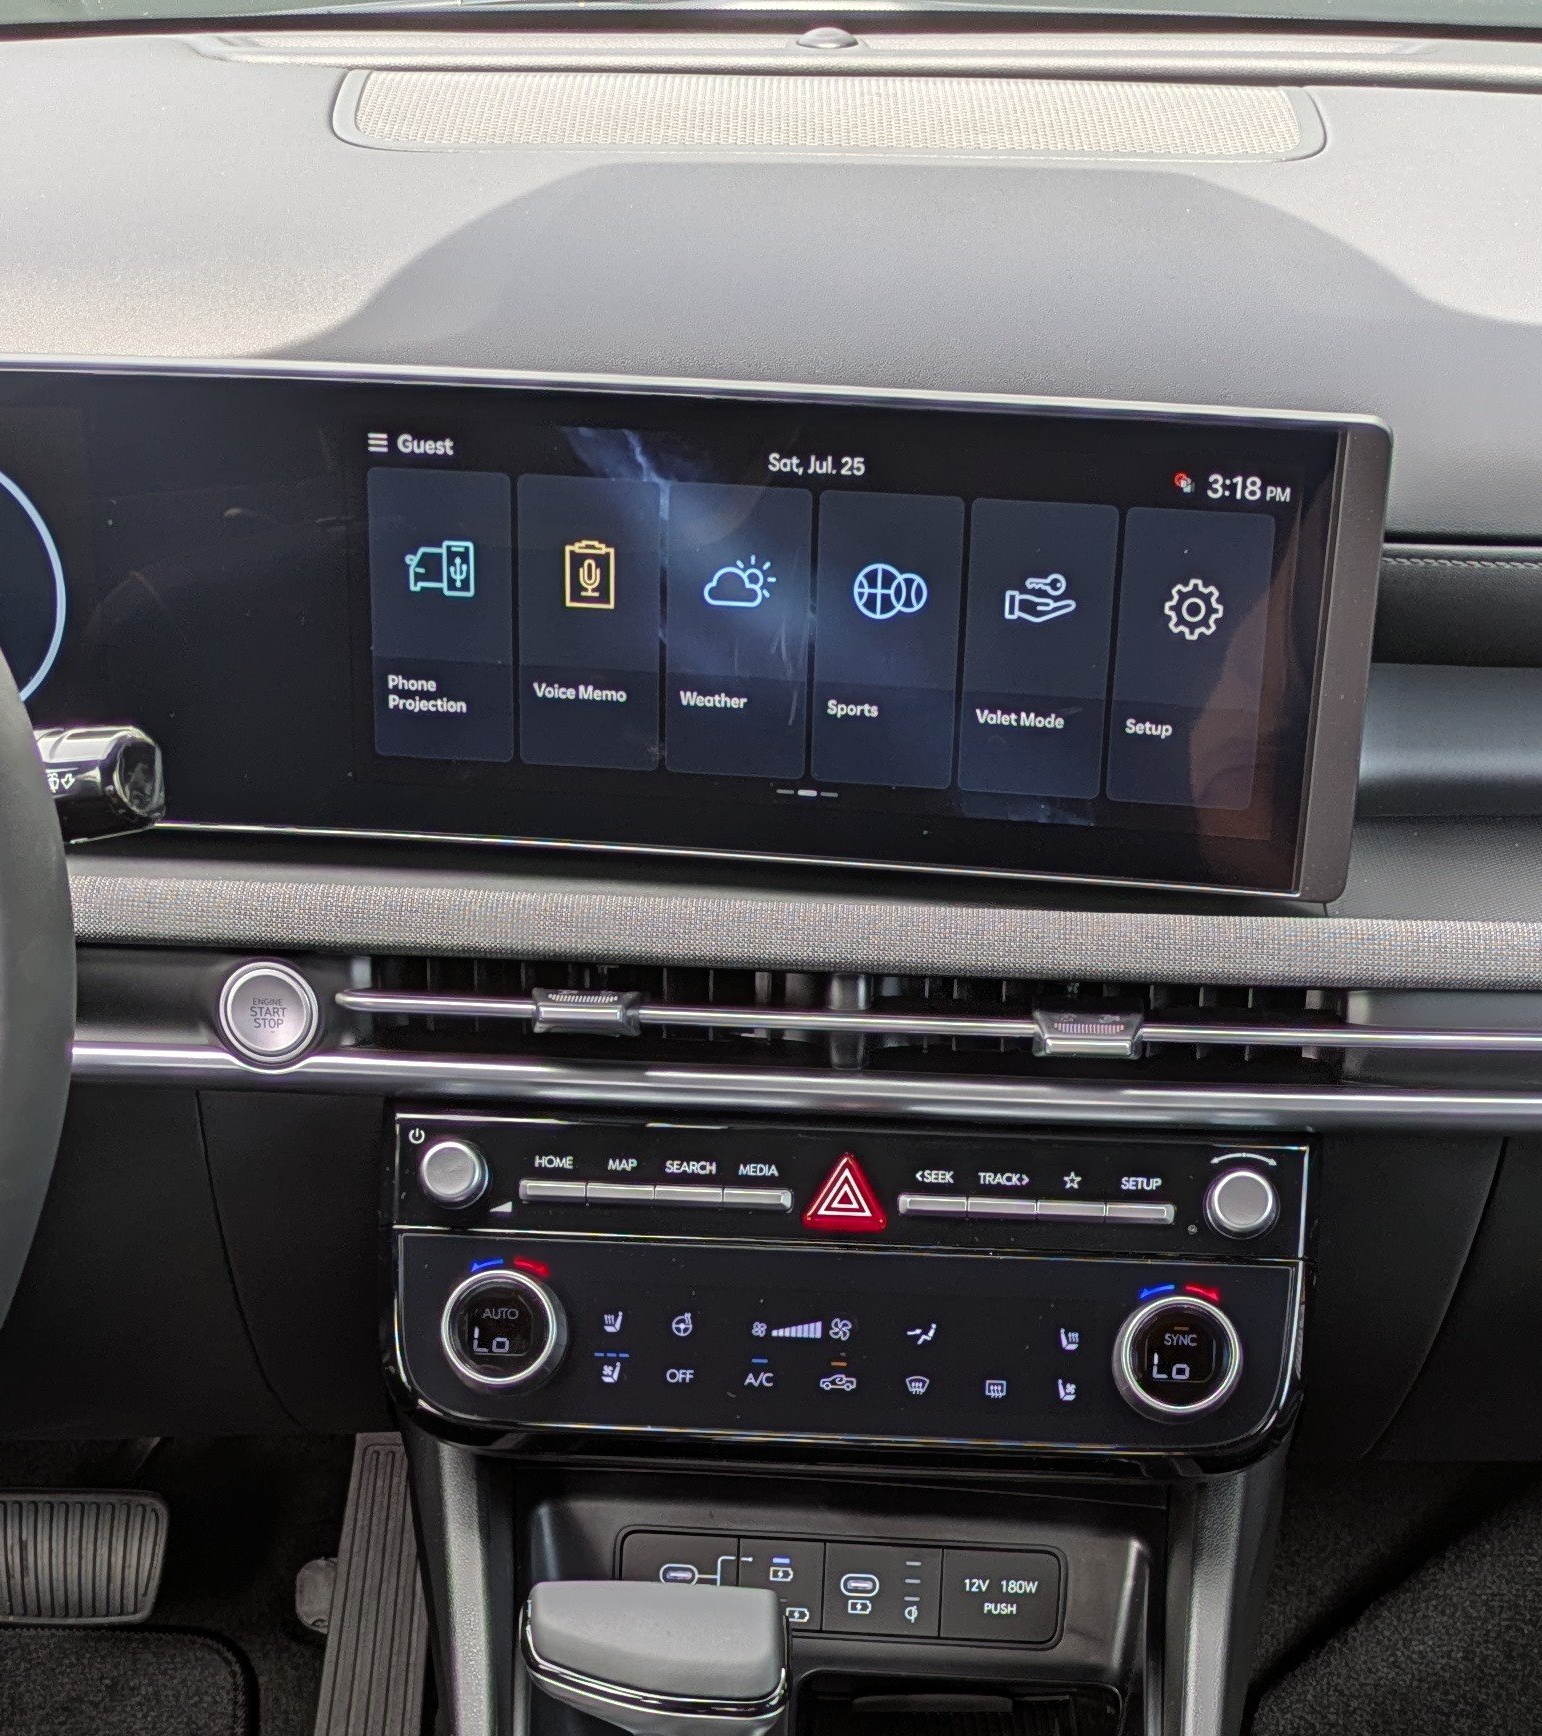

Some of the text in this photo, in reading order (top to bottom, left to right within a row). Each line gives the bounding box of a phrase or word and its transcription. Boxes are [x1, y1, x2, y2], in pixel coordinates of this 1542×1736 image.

[396, 434, 454, 456] Guest
[768, 453, 866, 476] Sat, Jul. 25
[1207, 473, 1291, 503] 3:18 PM
[387, 674, 437, 692] Phone
[533, 682, 627, 703] Voice Memo
[679, 690, 748, 710] Weather
[388, 694, 467, 714] Projection
[826, 699, 879, 719] Sports
[975, 708, 1065, 730] Valet Mode
[1125, 718, 1173, 739] Setup
[252, 997, 283, 1006] ENGINE
[250, 1006, 287, 1018] START
[253, 1018, 284, 1029] STOP
[534, 1155, 574, 1169] HOME
[608, 1158, 638, 1171] MAP
[665, 1160, 716, 1175] SEARCH
[738, 1164, 779, 1178] MEDIA
[1121, 1176, 1162, 1191] SETUP
[482, 1307, 519, 1320] AUTO
[473, 1326, 510, 1353] Lo
[1164, 1332, 1198, 1347] SYNC
[1152, 1352, 1190, 1380] Lo
[666, 1368, 695, 1384] OFF
[743, 1372, 774, 1388] A/C
[964, 1578, 1038, 1594] 12V 180W
[984, 1603, 1017, 1615] PUSH
